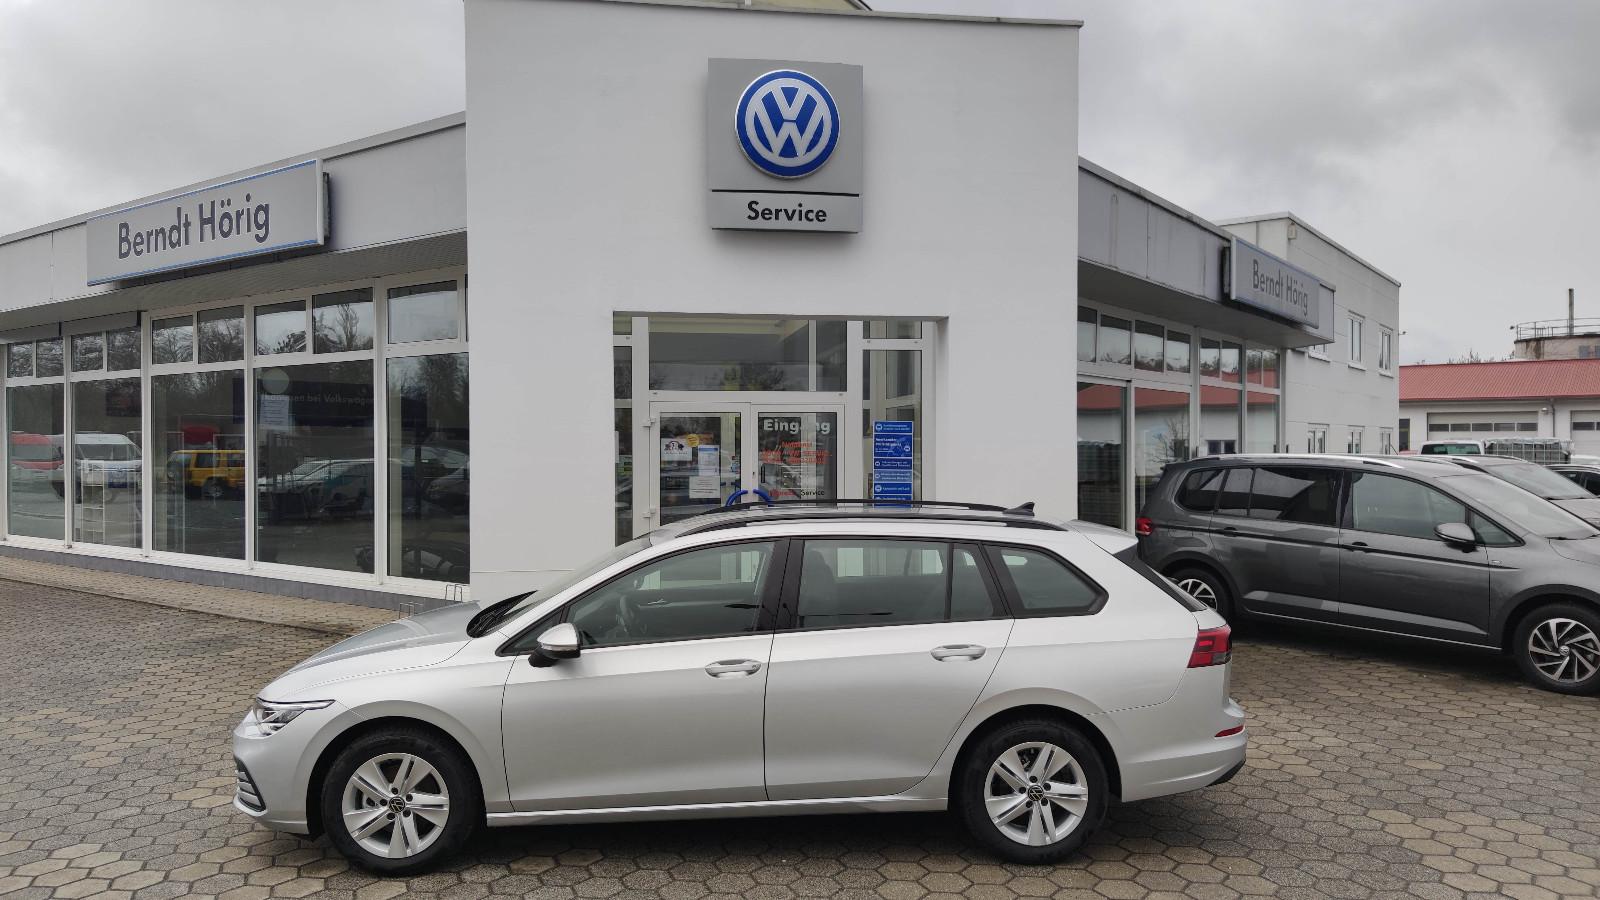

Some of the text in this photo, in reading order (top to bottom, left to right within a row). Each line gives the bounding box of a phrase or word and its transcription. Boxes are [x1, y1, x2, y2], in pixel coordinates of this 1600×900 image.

[745, 78, 832, 167] VW
[118, 193, 269, 259] Berndt Hörig
[747, 201, 827, 222] Service
[1253, 259, 1308, 317] Berndt Hörig
[763, 419, 831, 434] Eingg
